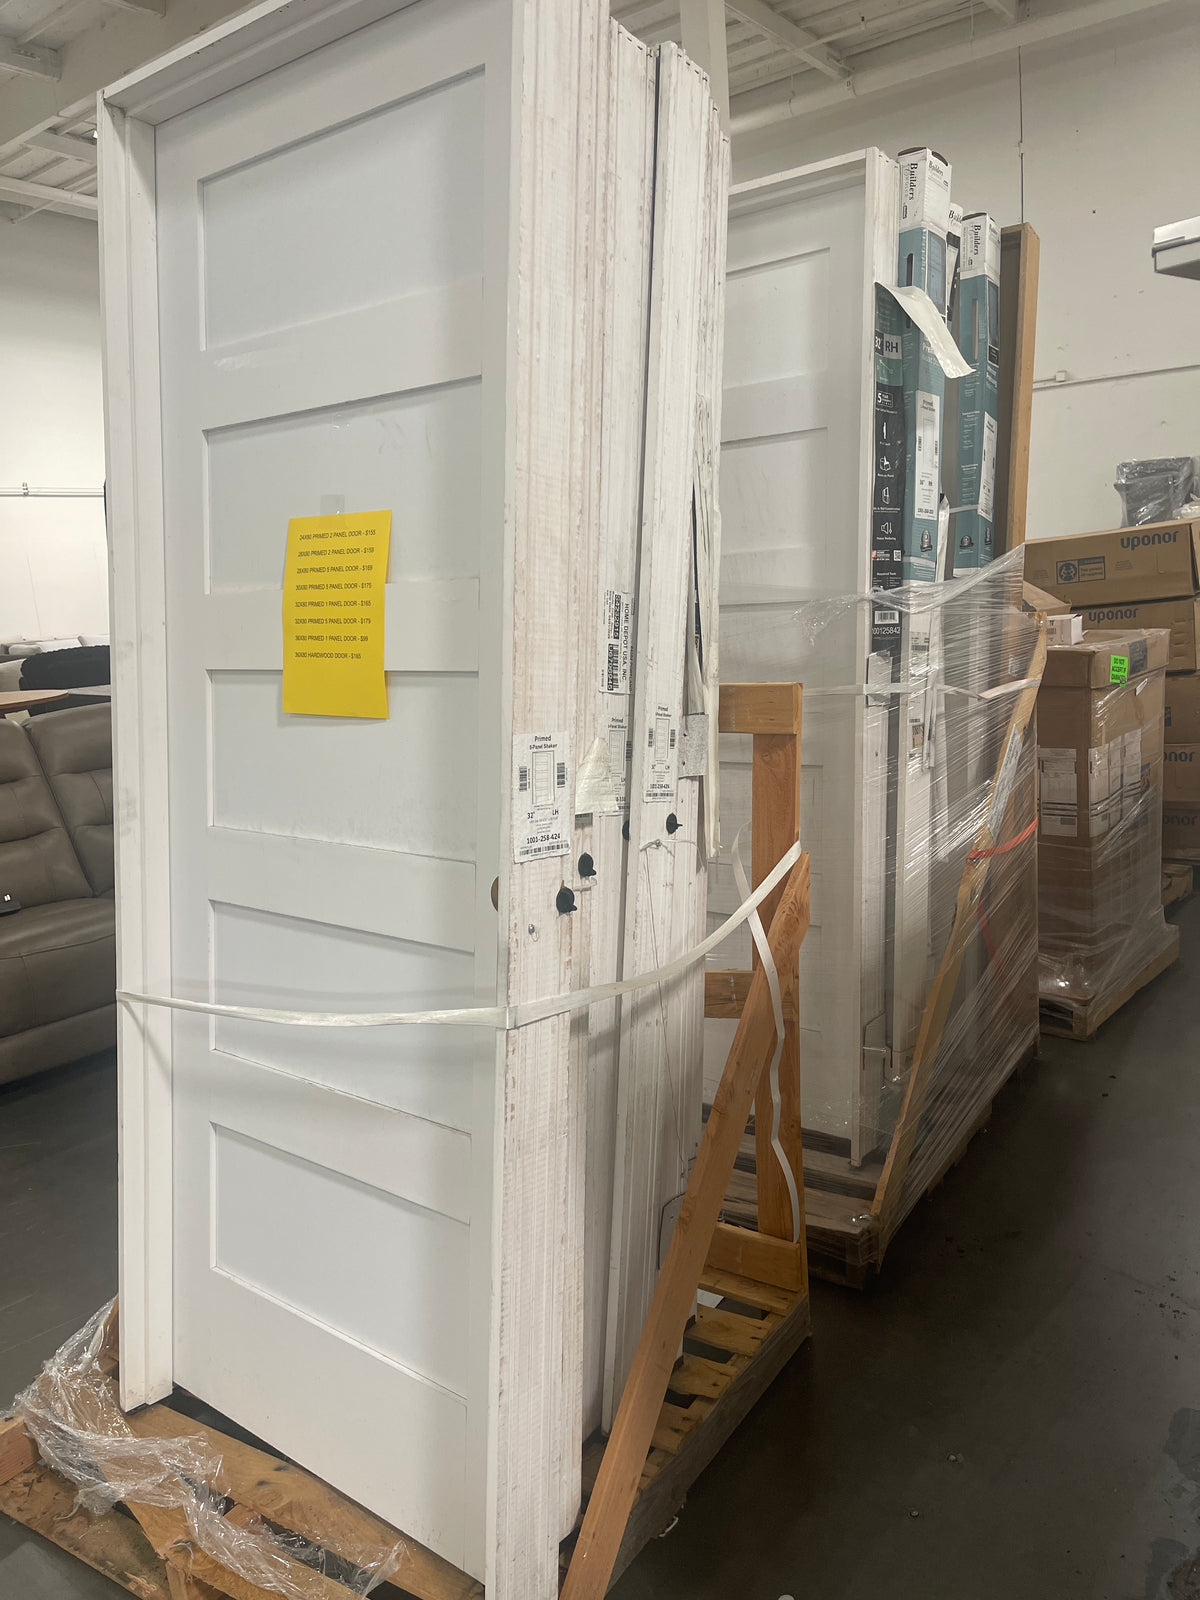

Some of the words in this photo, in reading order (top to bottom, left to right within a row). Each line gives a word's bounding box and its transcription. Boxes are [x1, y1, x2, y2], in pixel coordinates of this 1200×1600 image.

[909, 163, 918, 200] Builders
[885, 341, 898, 353] RH
[878, 392, 882, 403] 5
[1120, 531, 1179, 550] uponor
[1089, 608, 1140, 624] uponor
